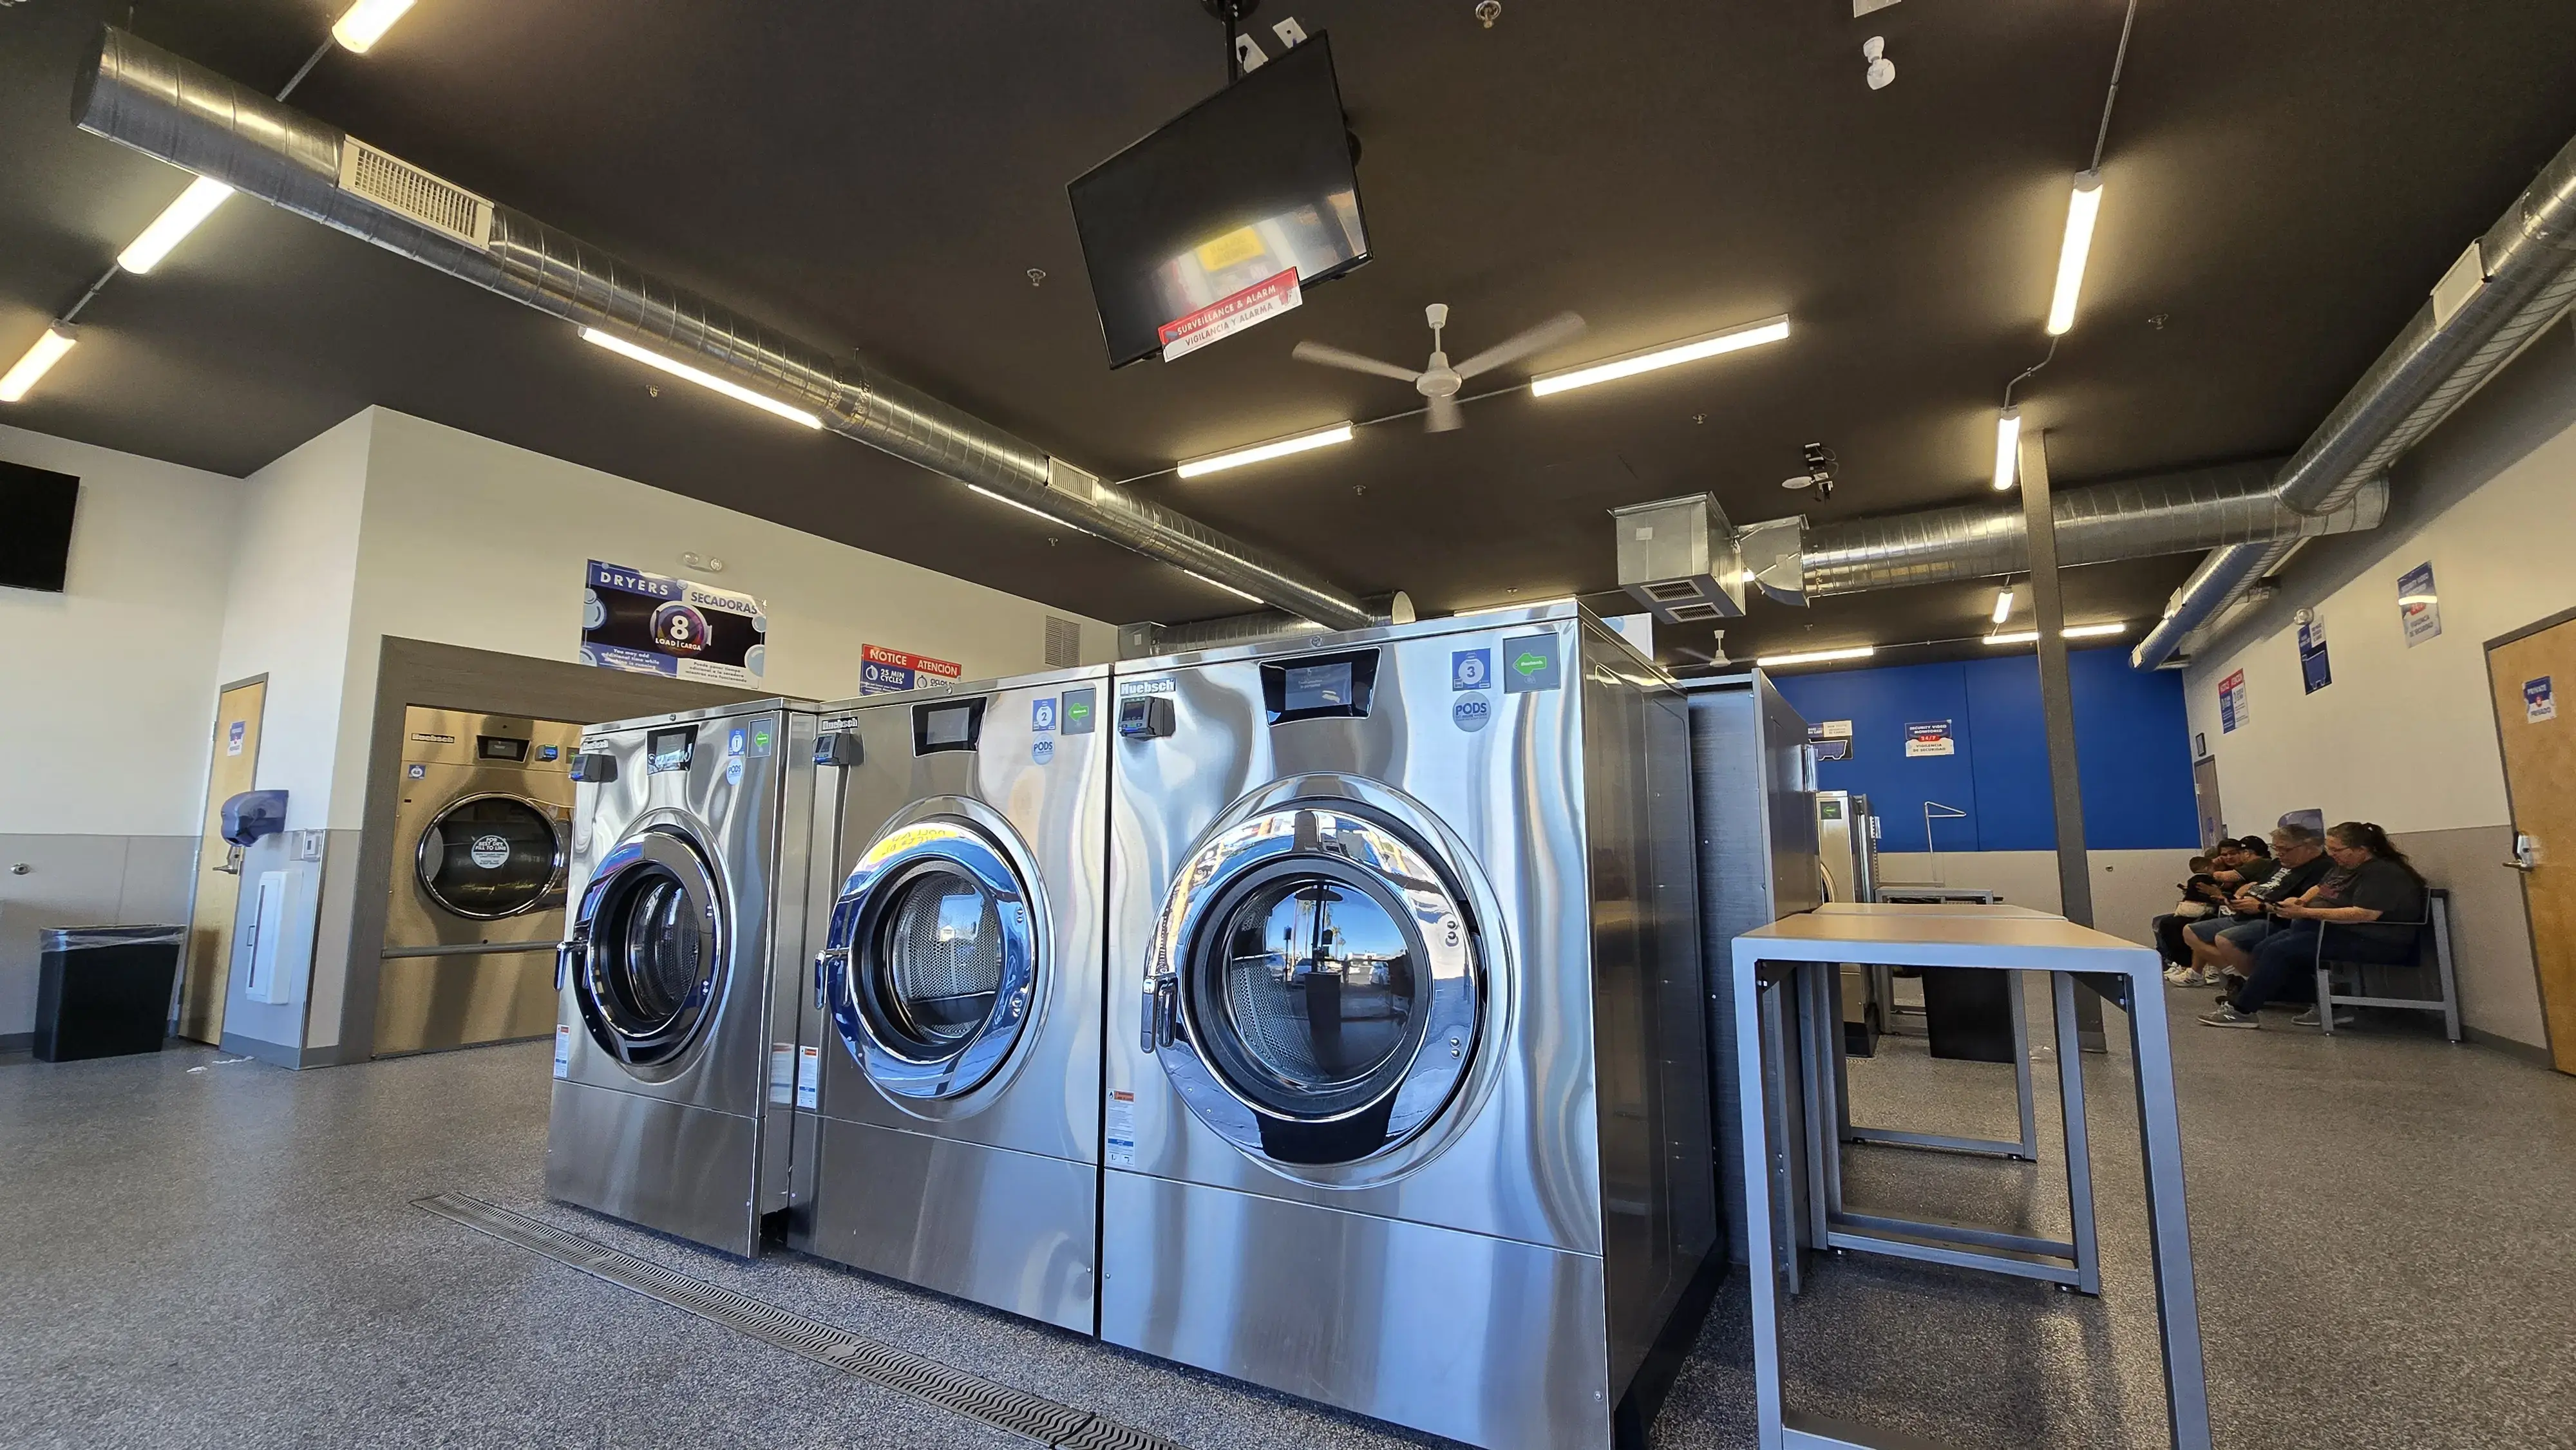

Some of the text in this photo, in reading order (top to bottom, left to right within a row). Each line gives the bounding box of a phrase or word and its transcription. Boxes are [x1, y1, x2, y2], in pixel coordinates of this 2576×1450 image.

[1177, 303, 1235, 335] SURVEILLANCE
[1246, 284, 1276, 305] ALARM
[1185, 303, 1274, 346] VIGILANCIA Y ALARMA
[600, 572, 668, 596] DRYERS
[690, 592, 757, 614] SECADORAS
[670, 616, 688, 640] 8
[656, 637, 701, 651] LOAD CARGA
[870, 648, 907, 666] NOTICE
[880, 675, 903, 684] CYCLES
[891, 670, 905, 679] MIN
[1466, 666, 1475, 678] 3
[1121, 679, 1175, 695] Huebsch
[1455, 702, 1487, 715] PODS
[1041, 711, 1047, 722] 2
[1034, 741, 1053, 752] PODS
